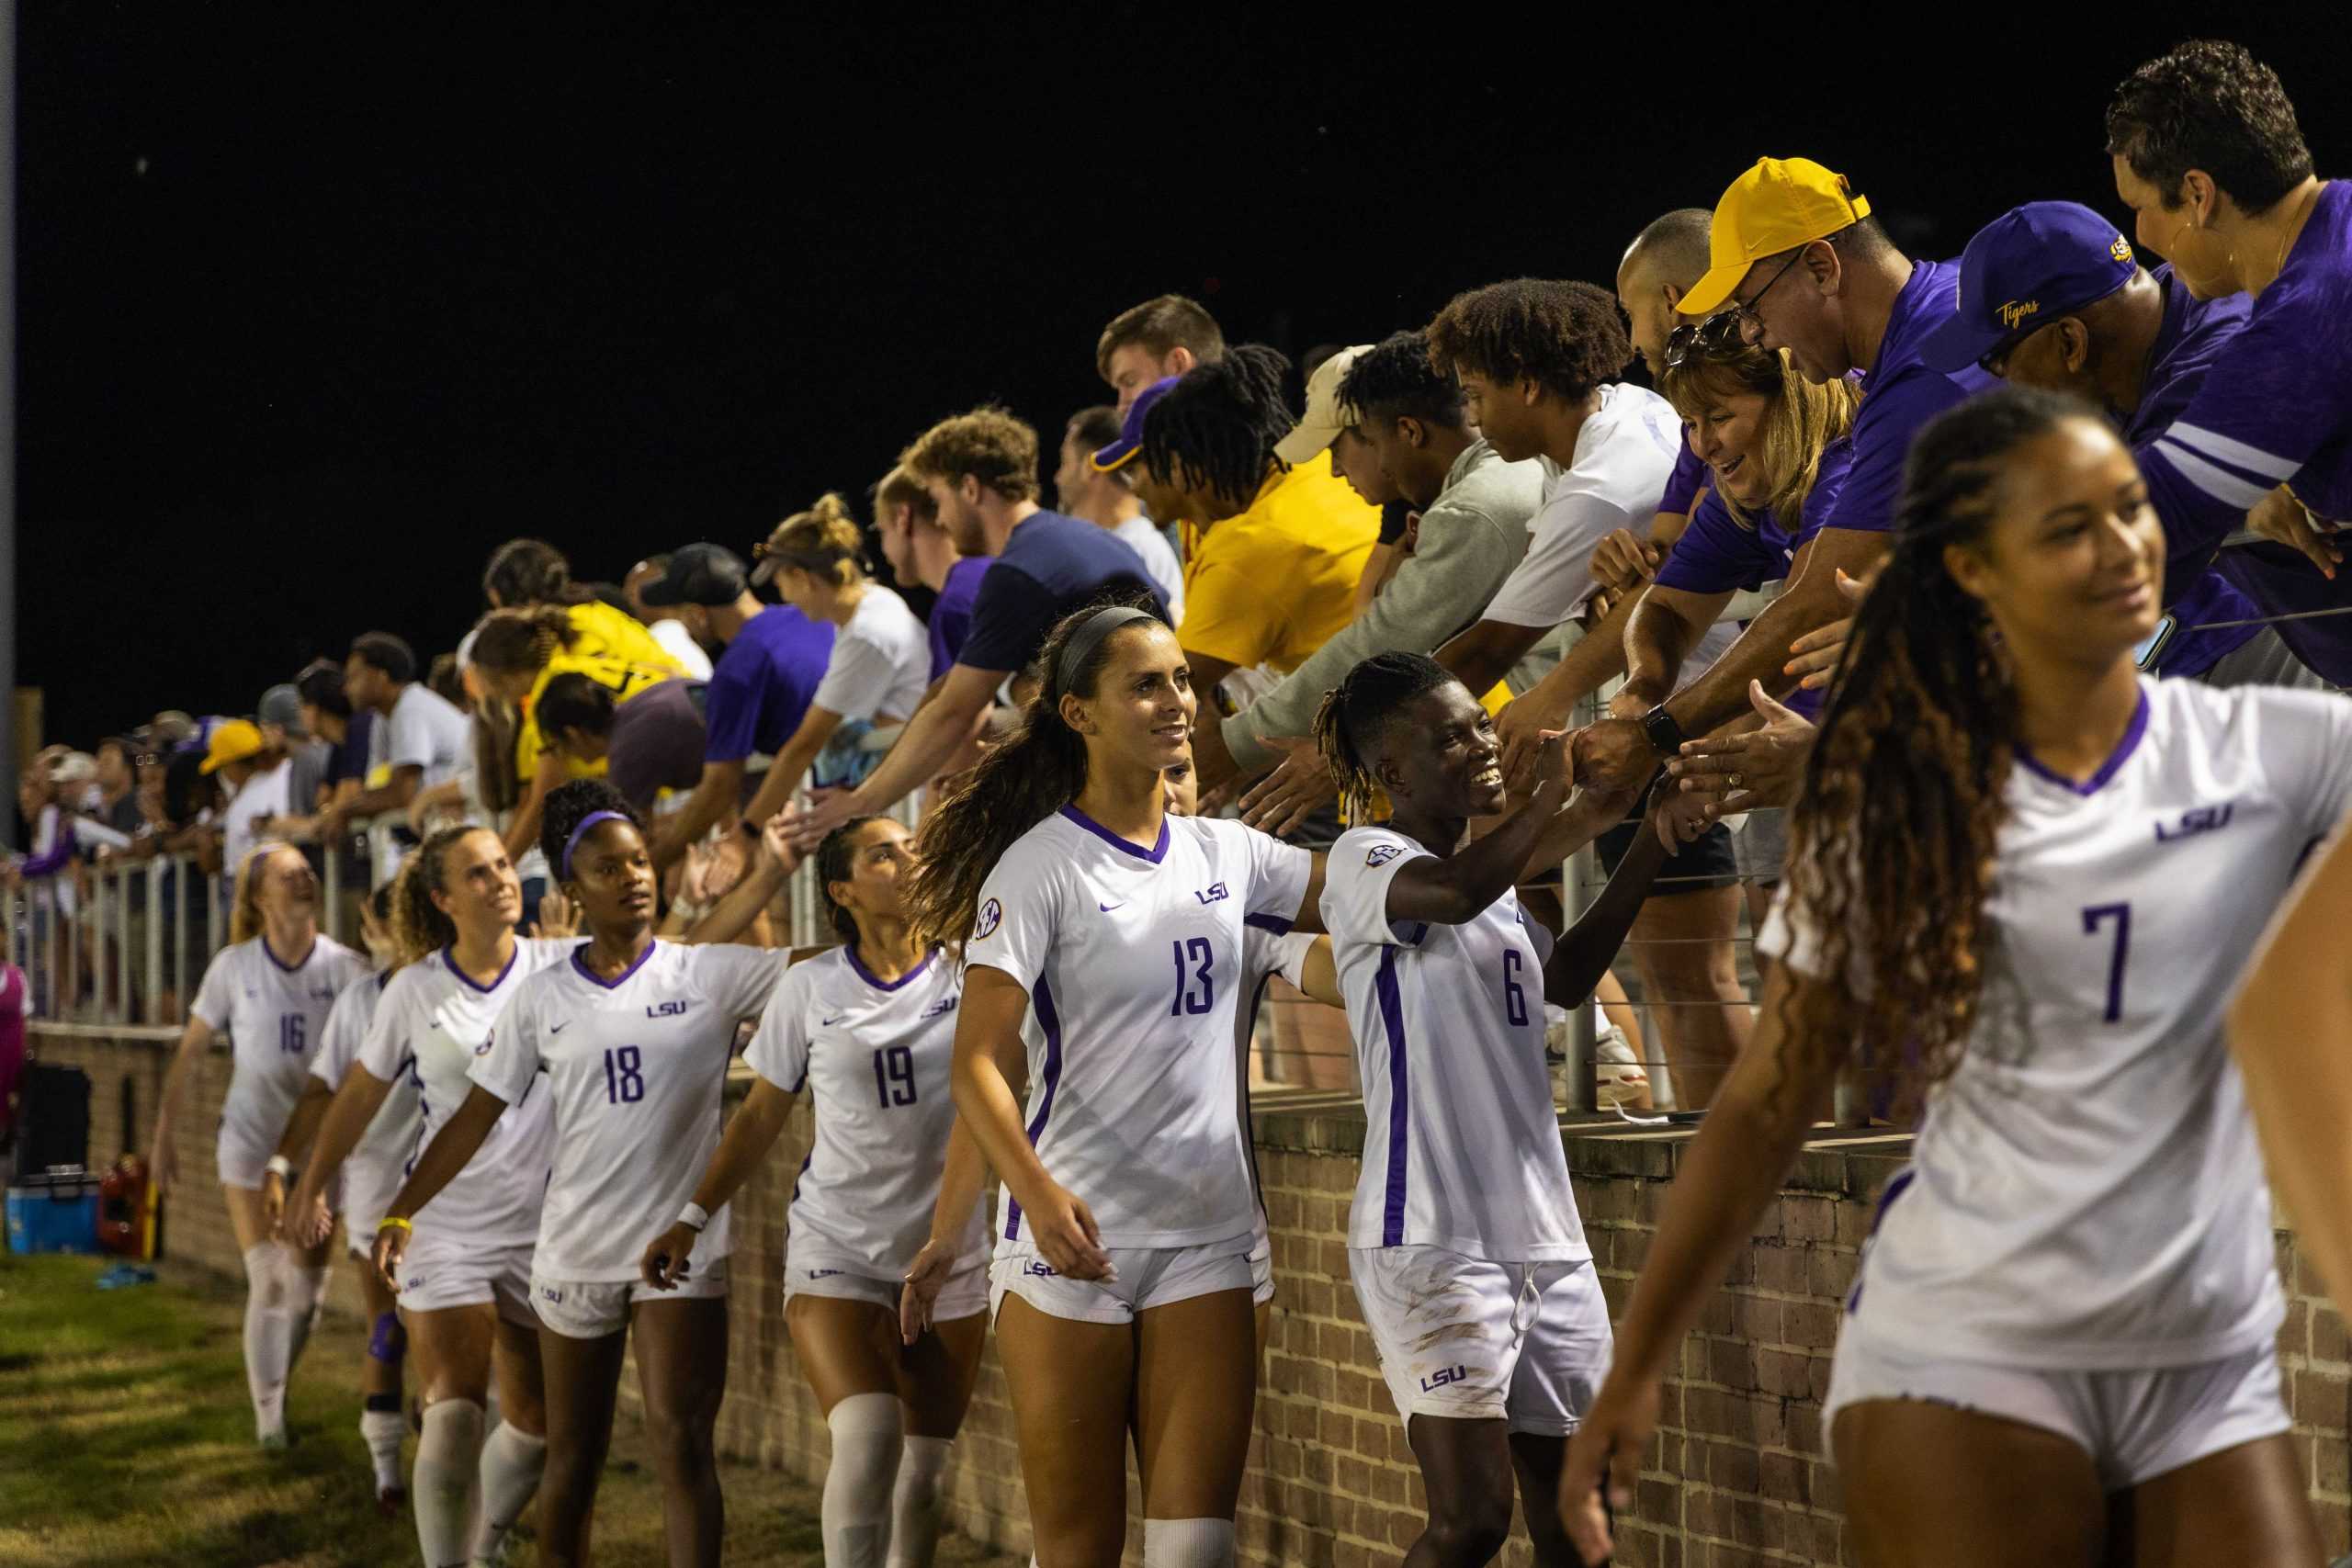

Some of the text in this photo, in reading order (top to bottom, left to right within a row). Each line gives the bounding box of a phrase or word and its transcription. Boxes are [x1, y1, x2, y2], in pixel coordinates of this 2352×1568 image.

[1995, 300, 2040, 329] Tigers
[2155, 803, 2233, 842] LSU
[1194, 881, 1229, 905] LSU
[1171, 937, 1214, 1016] 13
[2082, 902, 2131, 1024] 7
[1503, 948, 1530, 1026] 6
[647, 999, 686, 1018] LSU
[280, 1014, 306, 1054] 16
[605, 1045, 645, 1104] 18
[875, 1045, 917, 1109] 19
[1420, 1365, 1466, 1393] LSU
